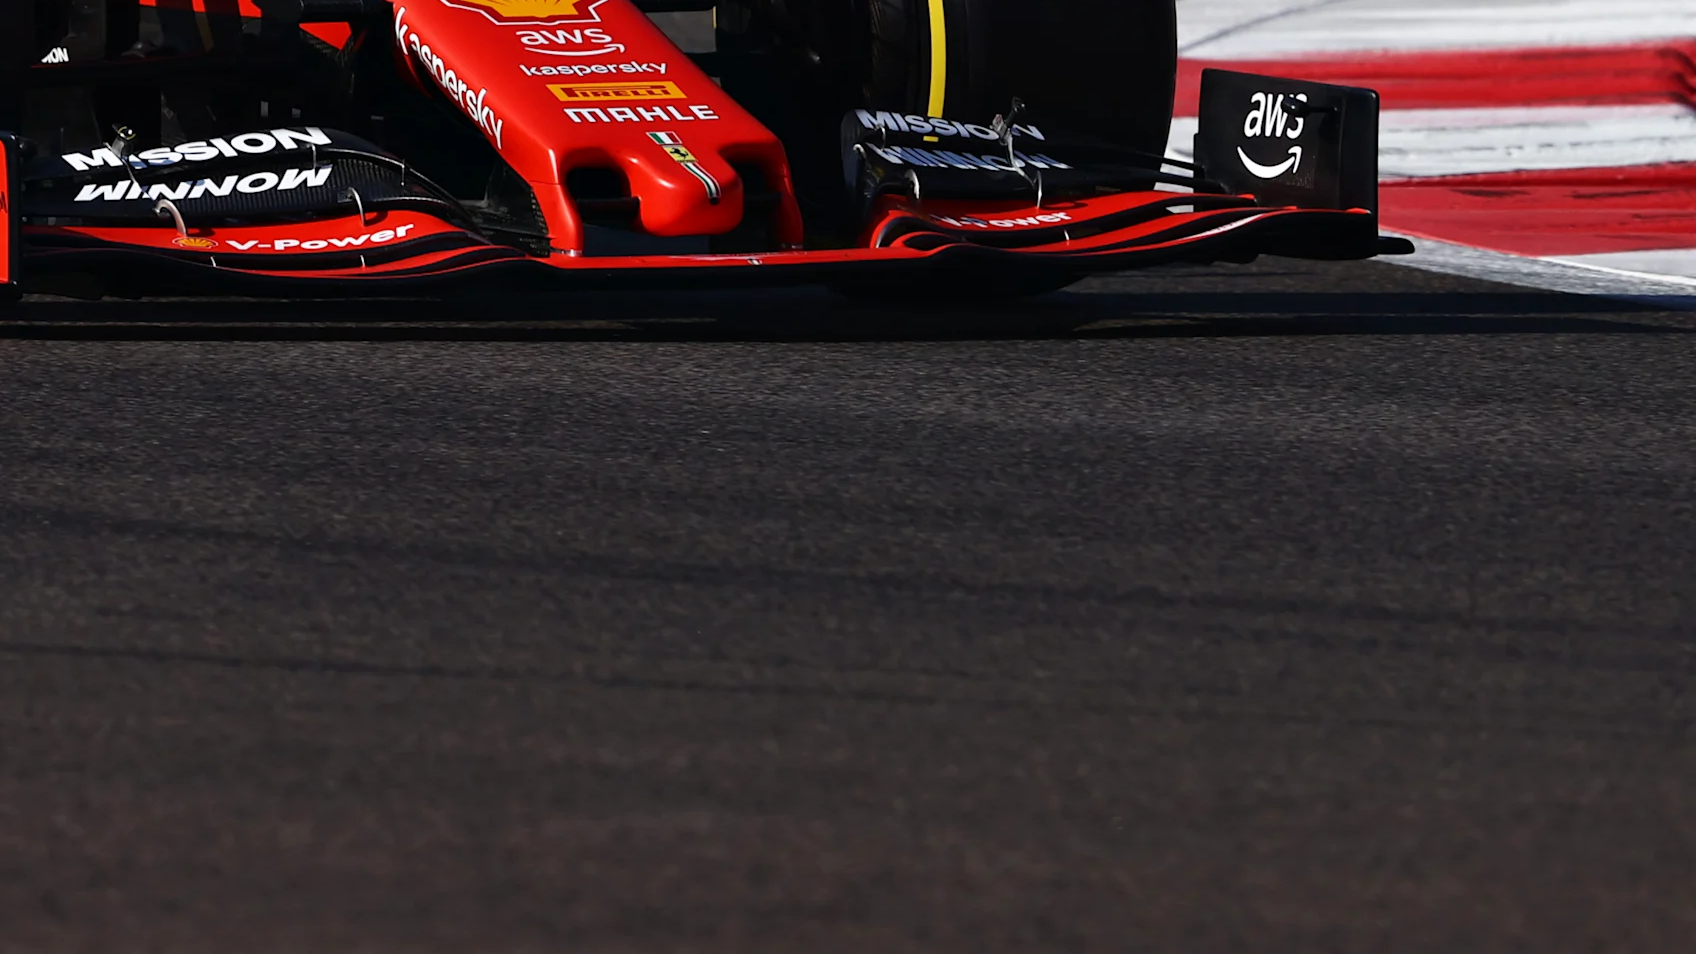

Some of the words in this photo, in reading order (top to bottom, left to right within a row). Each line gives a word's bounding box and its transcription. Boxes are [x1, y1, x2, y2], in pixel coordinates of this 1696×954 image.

[515, 28, 614, 47] aws
[394, 5, 504, 150] kaspersky
[519, 60, 667, 77] kaspersky
[560, 85, 673, 98] PIRELLI
[563, 105, 719, 123] MAHLE
[855, 109, 1046, 141] MISSION
[1244, 92, 1308, 139] aws
[62, 126, 332, 171] MISSION
[865, 142, 1074, 171] WINNOW
[73, 164, 333, 201] WINNOW
[930, 211, 1072, 228] V-Power
[225, 223, 414, 251] V-Power
